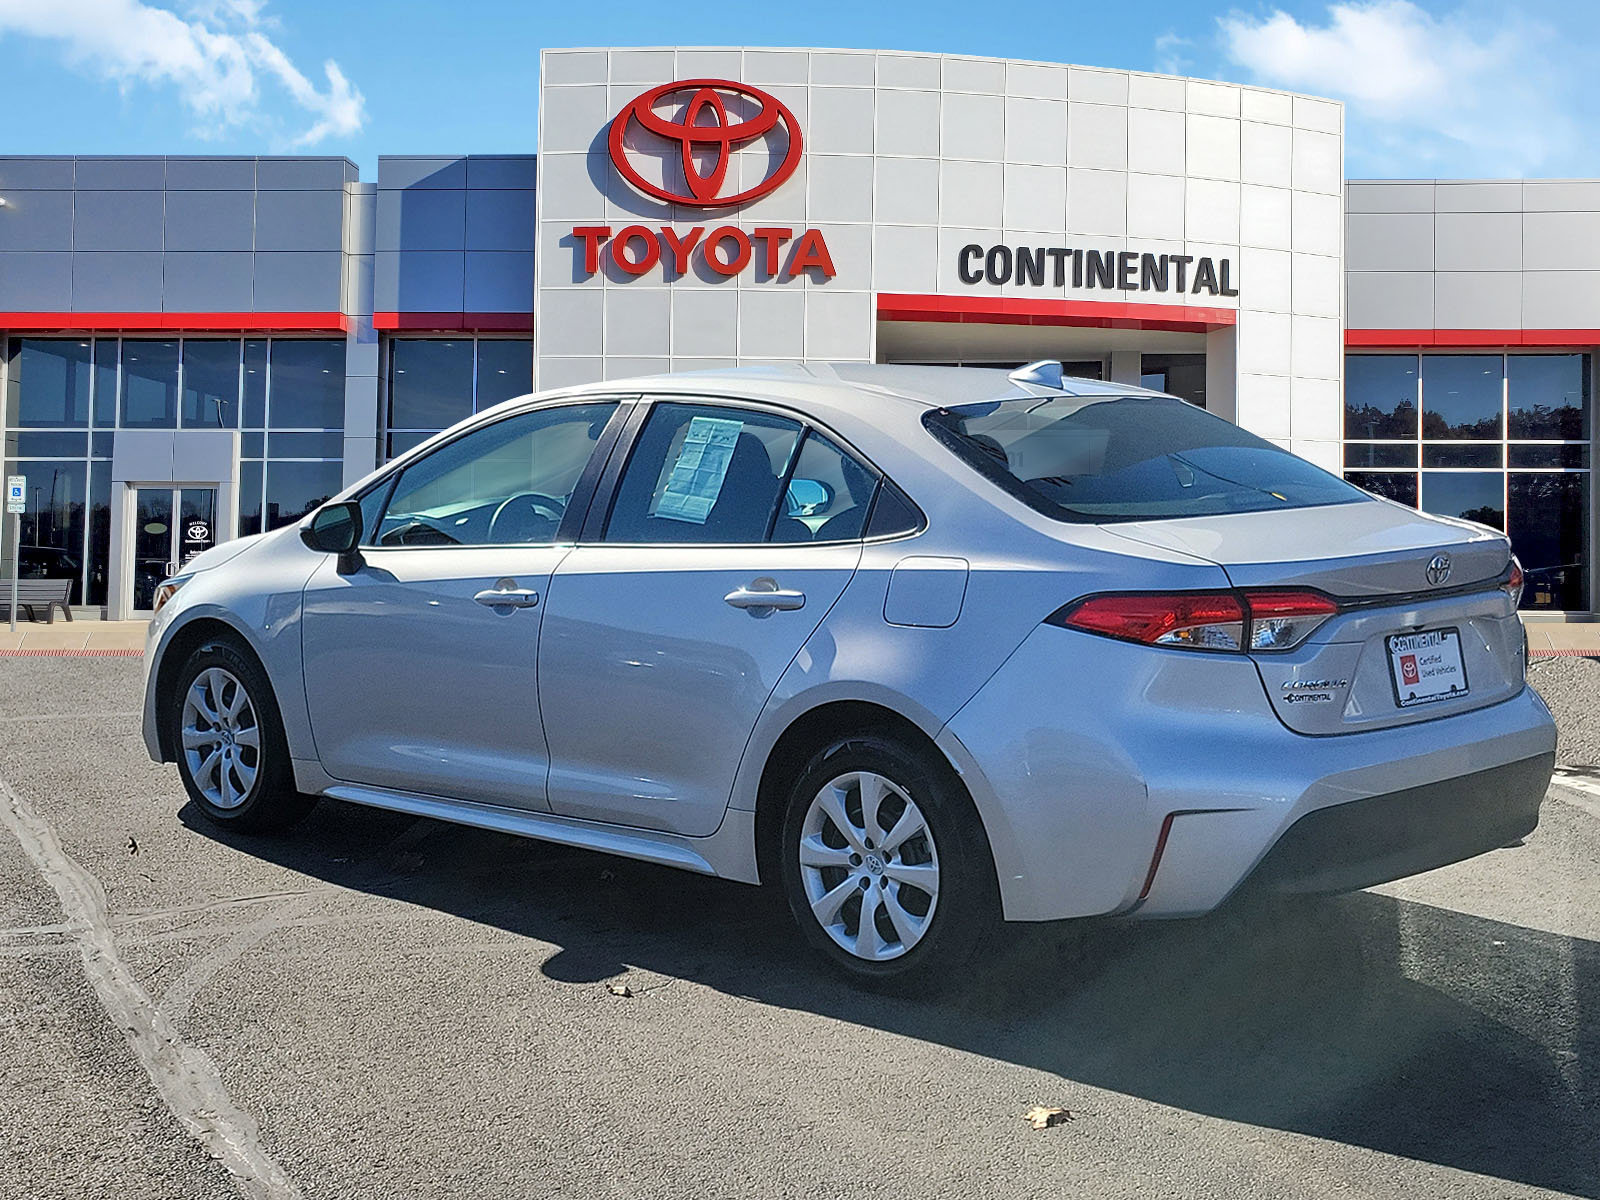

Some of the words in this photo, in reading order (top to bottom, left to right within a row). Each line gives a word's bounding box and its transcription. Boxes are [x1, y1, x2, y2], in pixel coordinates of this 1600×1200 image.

[573, 225, 836, 277] TOYOTA
[959, 243, 1240, 297] CONTINENTAL
[1419, 653, 1442, 666] Certified
